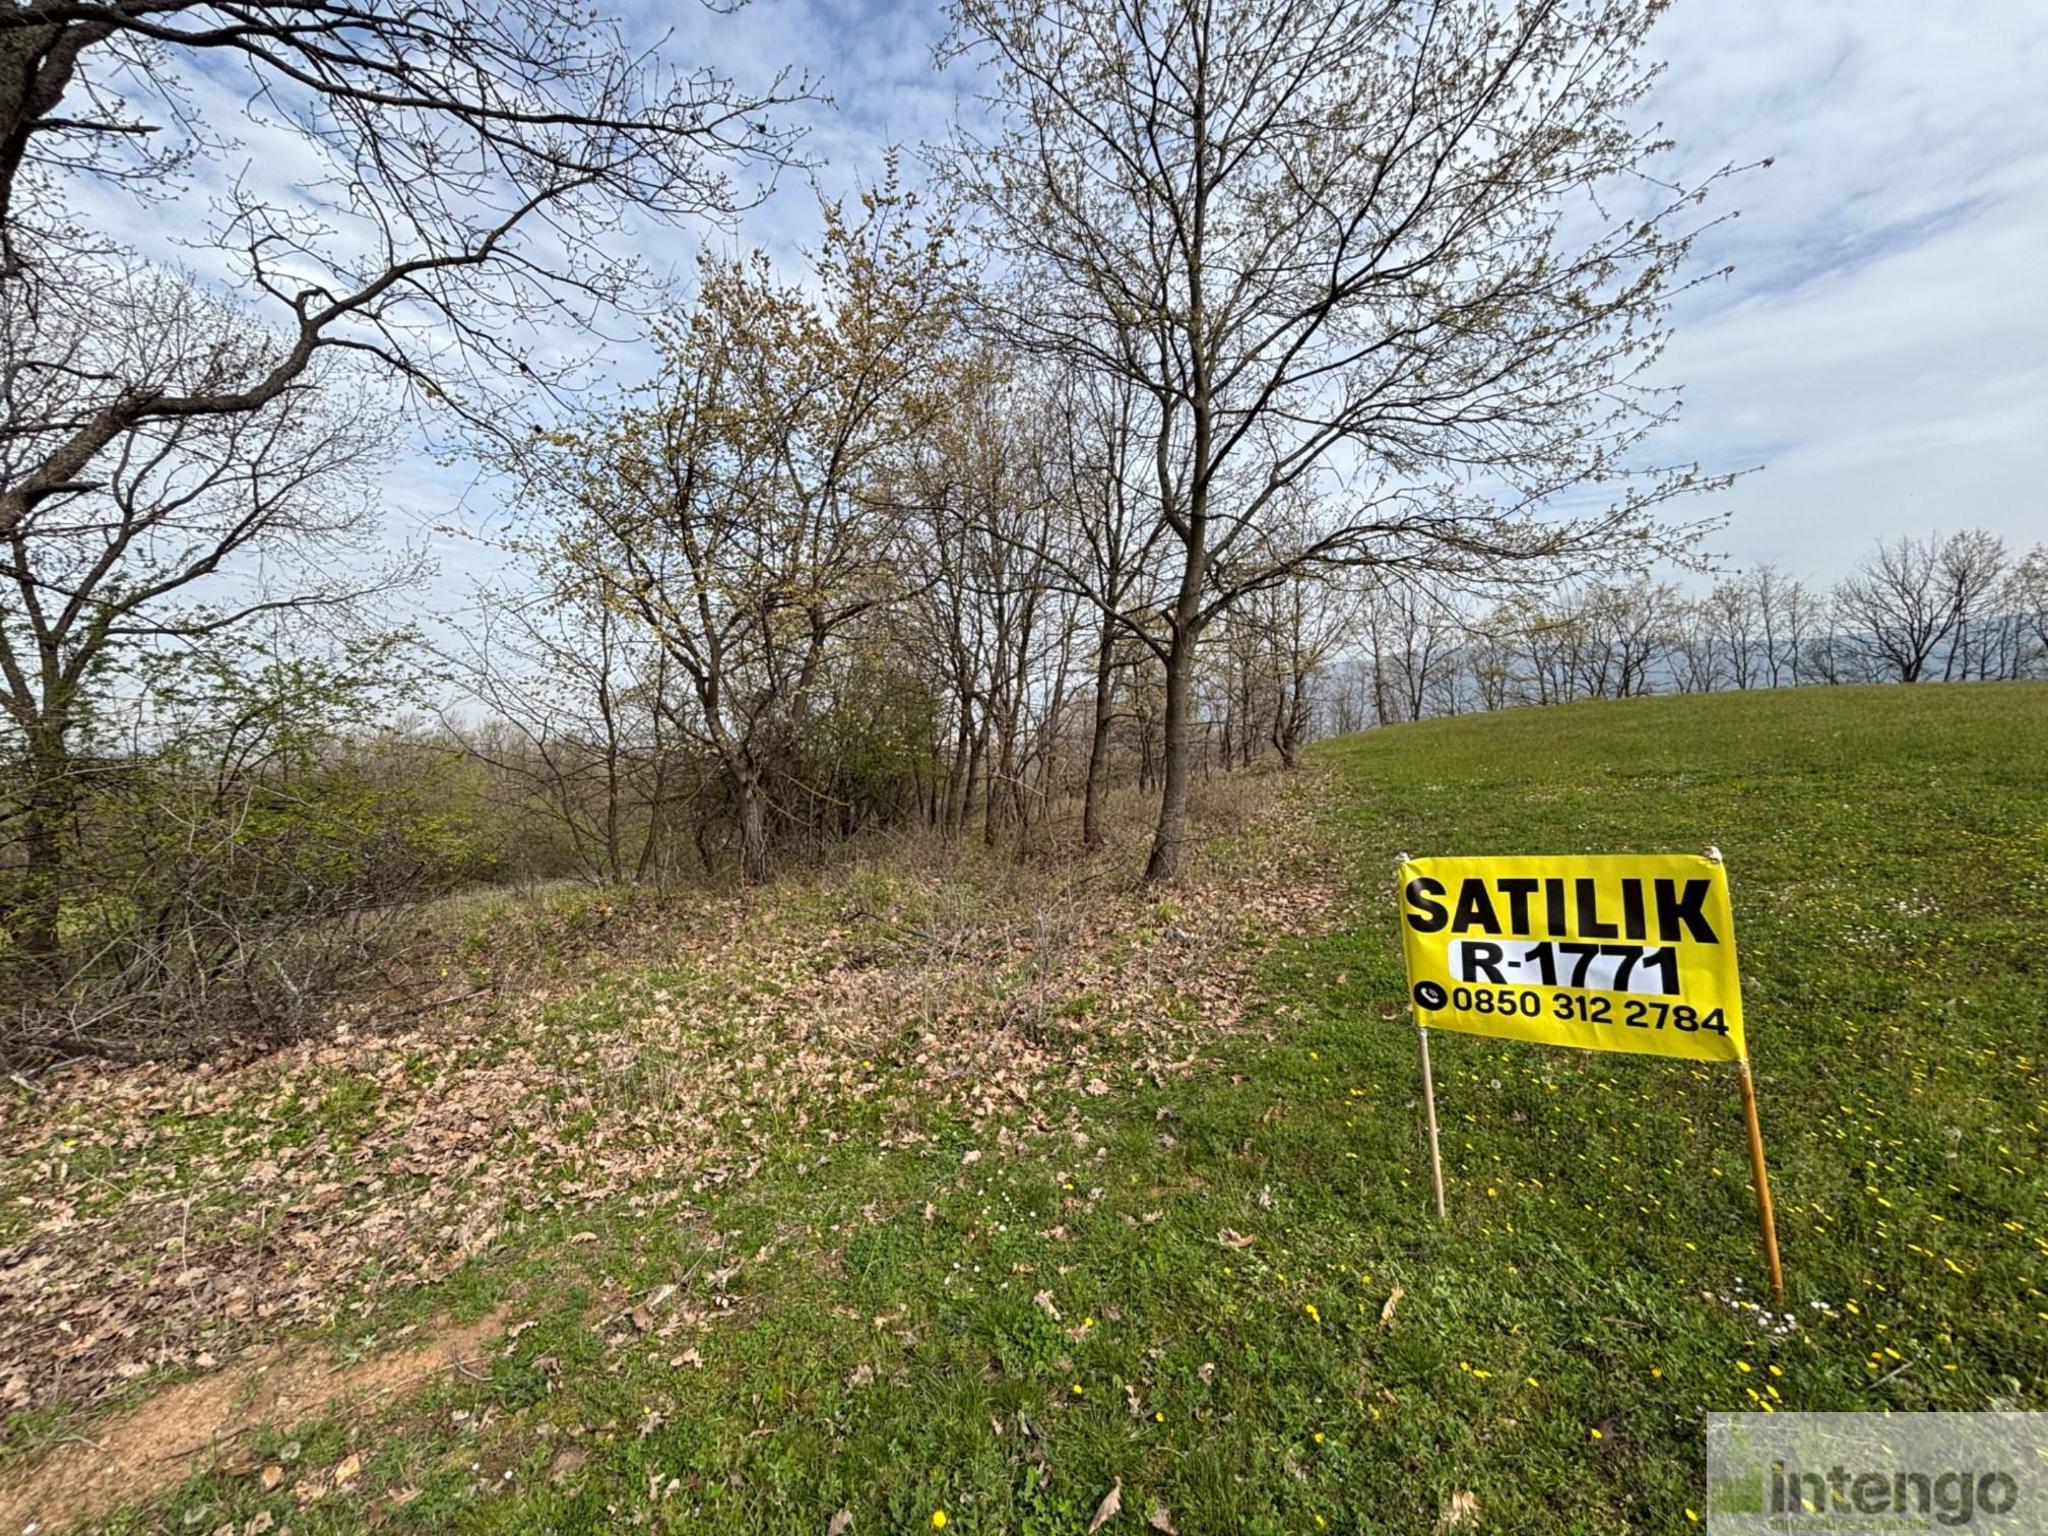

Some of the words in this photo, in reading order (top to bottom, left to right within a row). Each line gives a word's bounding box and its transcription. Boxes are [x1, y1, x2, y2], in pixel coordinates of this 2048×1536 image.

[1405, 877, 1719, 944] SATILIK
[1461, 941, 1680, 995] R-1771
[1453, 987, 1541, 1017] 0850
[1553, 994, 1612, 1024] 312
[1625, 1000, 1729, 1035] 2784
